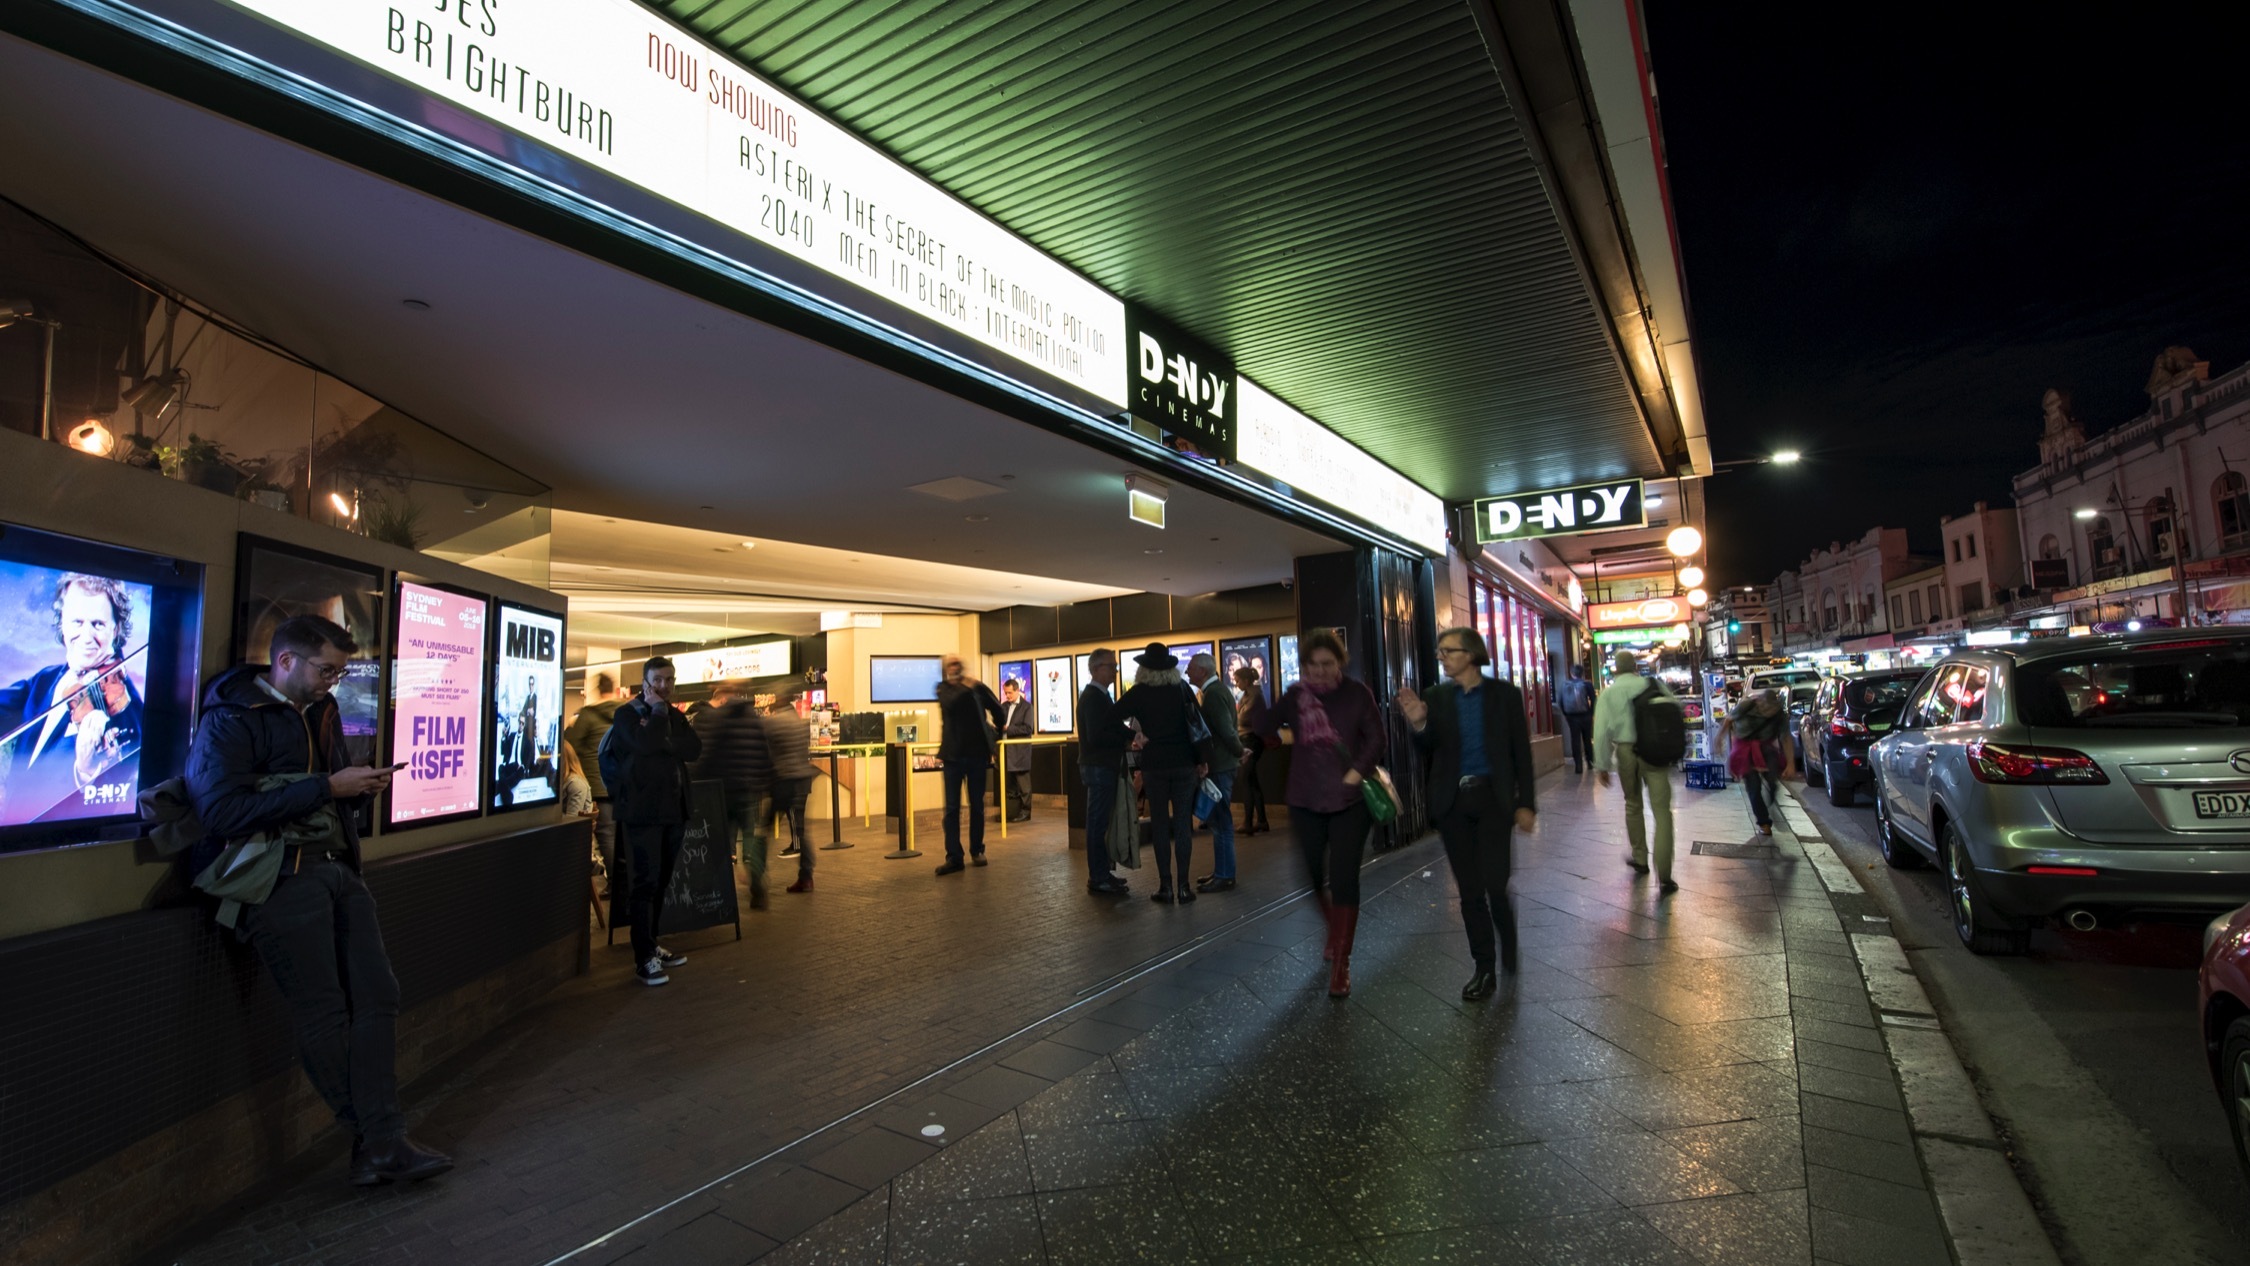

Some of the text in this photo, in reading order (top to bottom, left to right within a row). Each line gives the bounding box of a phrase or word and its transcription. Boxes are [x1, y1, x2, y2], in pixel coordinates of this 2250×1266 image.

[435, 0, 496, 36] ES
[387, 7, 613, 156] BRIGHTBURN
[649, 32, 797, 149] NOW SHOWING
[761, 195, 814, 249] 2040
[839, 232, 877, 280] MEN
[892, 258, 909, 294] IN
[918, 272, 967, 322] BLACK
[986, 306, 1085, 378] INTERNATIONAL
[843, 190, 877, 238] THE
[885, 213, 946, 272] SECRET
[957, 254, 973, 288] OF
[983, 266, 1005, 304] THE
[1063, 311, 1105, 357] POTION
[1139, 330, 1229, 419] DENDY
[1141, 387, 1226, 441] CINEMAS
[1488, 485, 1632, 535] DENDY
[406, 591, 443, 607] SYDNEY
[406, 601, 428, 613] FILM
[405, 611, 446, 627] FESTIVAL
[426, 641, 475, 655] UNMISSABLE
[426, 651, 435, 659] 12
[506, 621, 555, 663] MIB
[412, 715, 466, 746] FILM
[84, 783, 131, 800] DENDY
[84, 797, 126, 805] CINEMAS
[684, 818, 710, 839] weet
[682, 843, 708, 865] Soup
